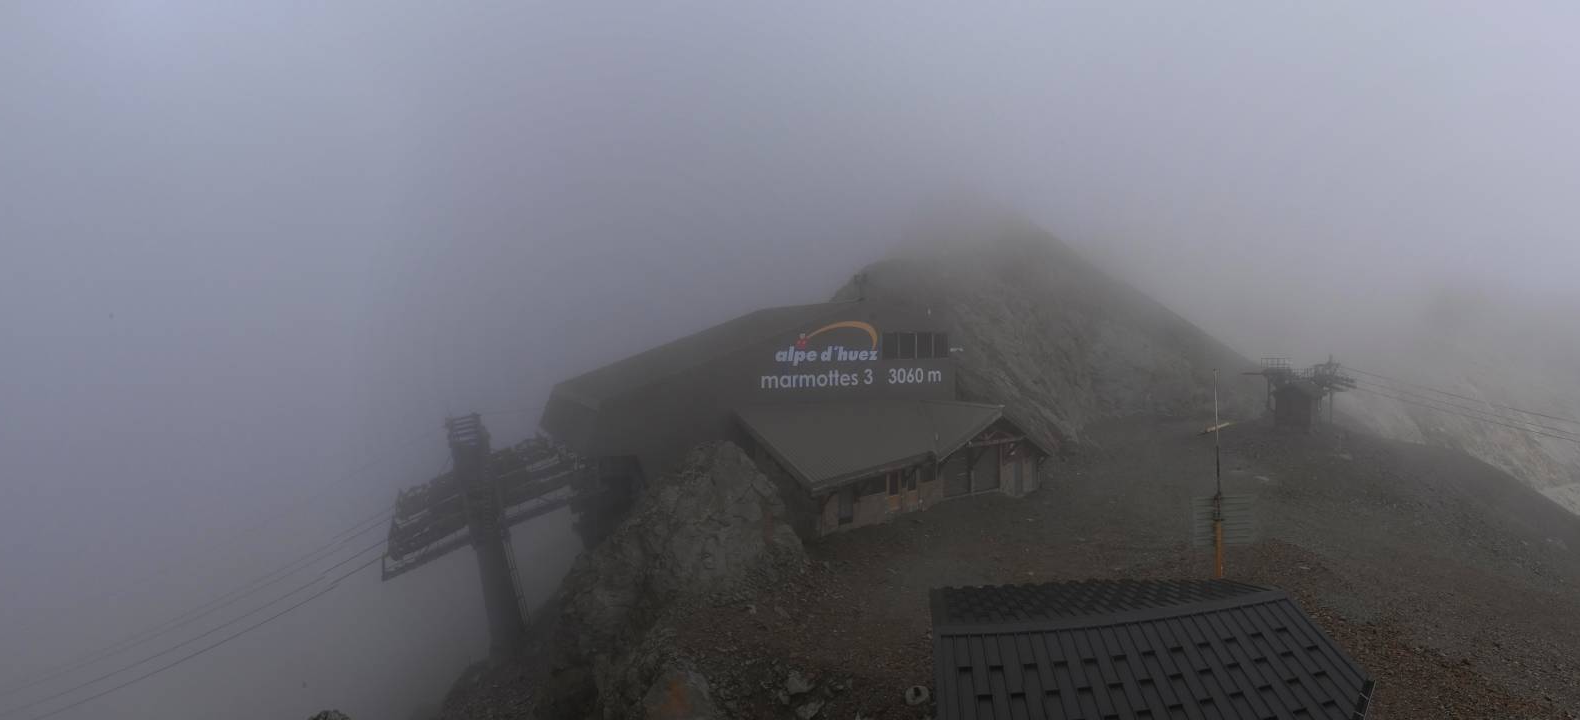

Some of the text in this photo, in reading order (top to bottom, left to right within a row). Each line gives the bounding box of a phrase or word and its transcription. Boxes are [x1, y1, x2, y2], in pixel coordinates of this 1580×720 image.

[775, 346, 818, 366] alpe
[761, 368, 942, 389] marmottes 3 3060 m
